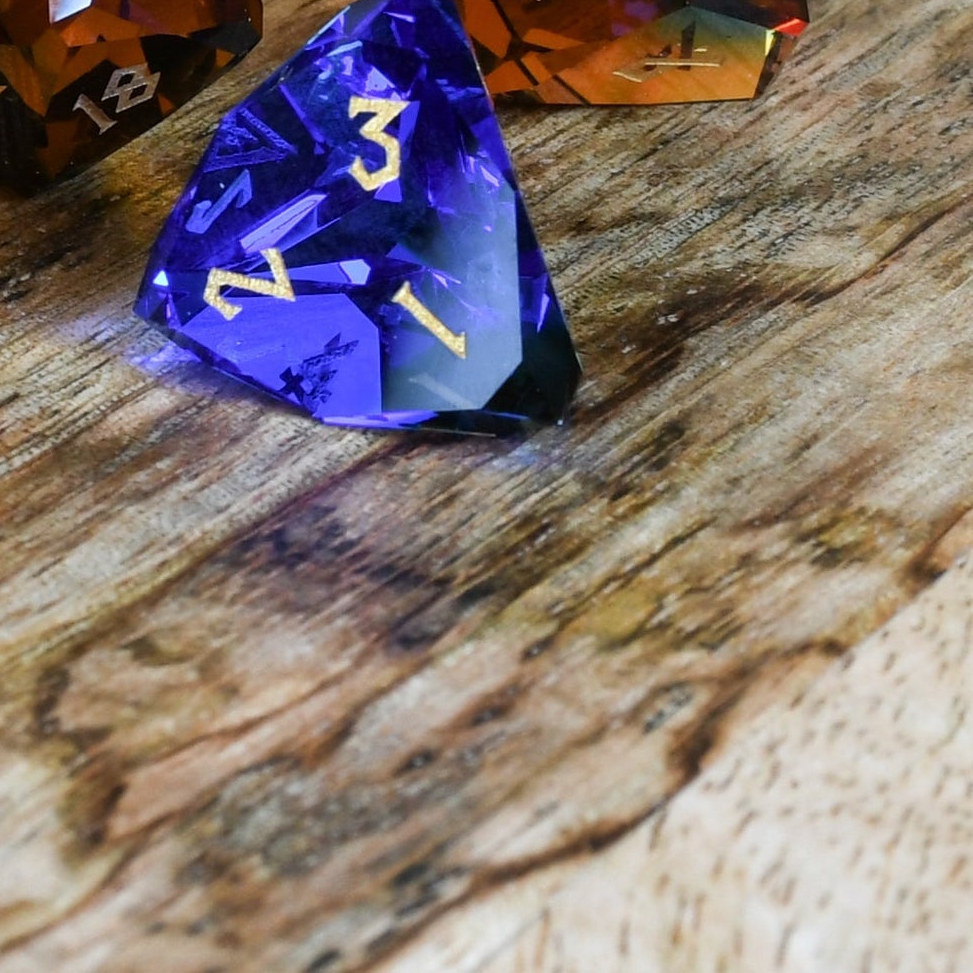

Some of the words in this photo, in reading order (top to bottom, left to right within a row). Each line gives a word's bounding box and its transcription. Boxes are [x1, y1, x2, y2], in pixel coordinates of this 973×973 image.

[72, 63, 160, 135] 18
[348, 96, 411, 192] 3
[203, 248, 296, 321] 2
[392, 281, 467, 359] 1
